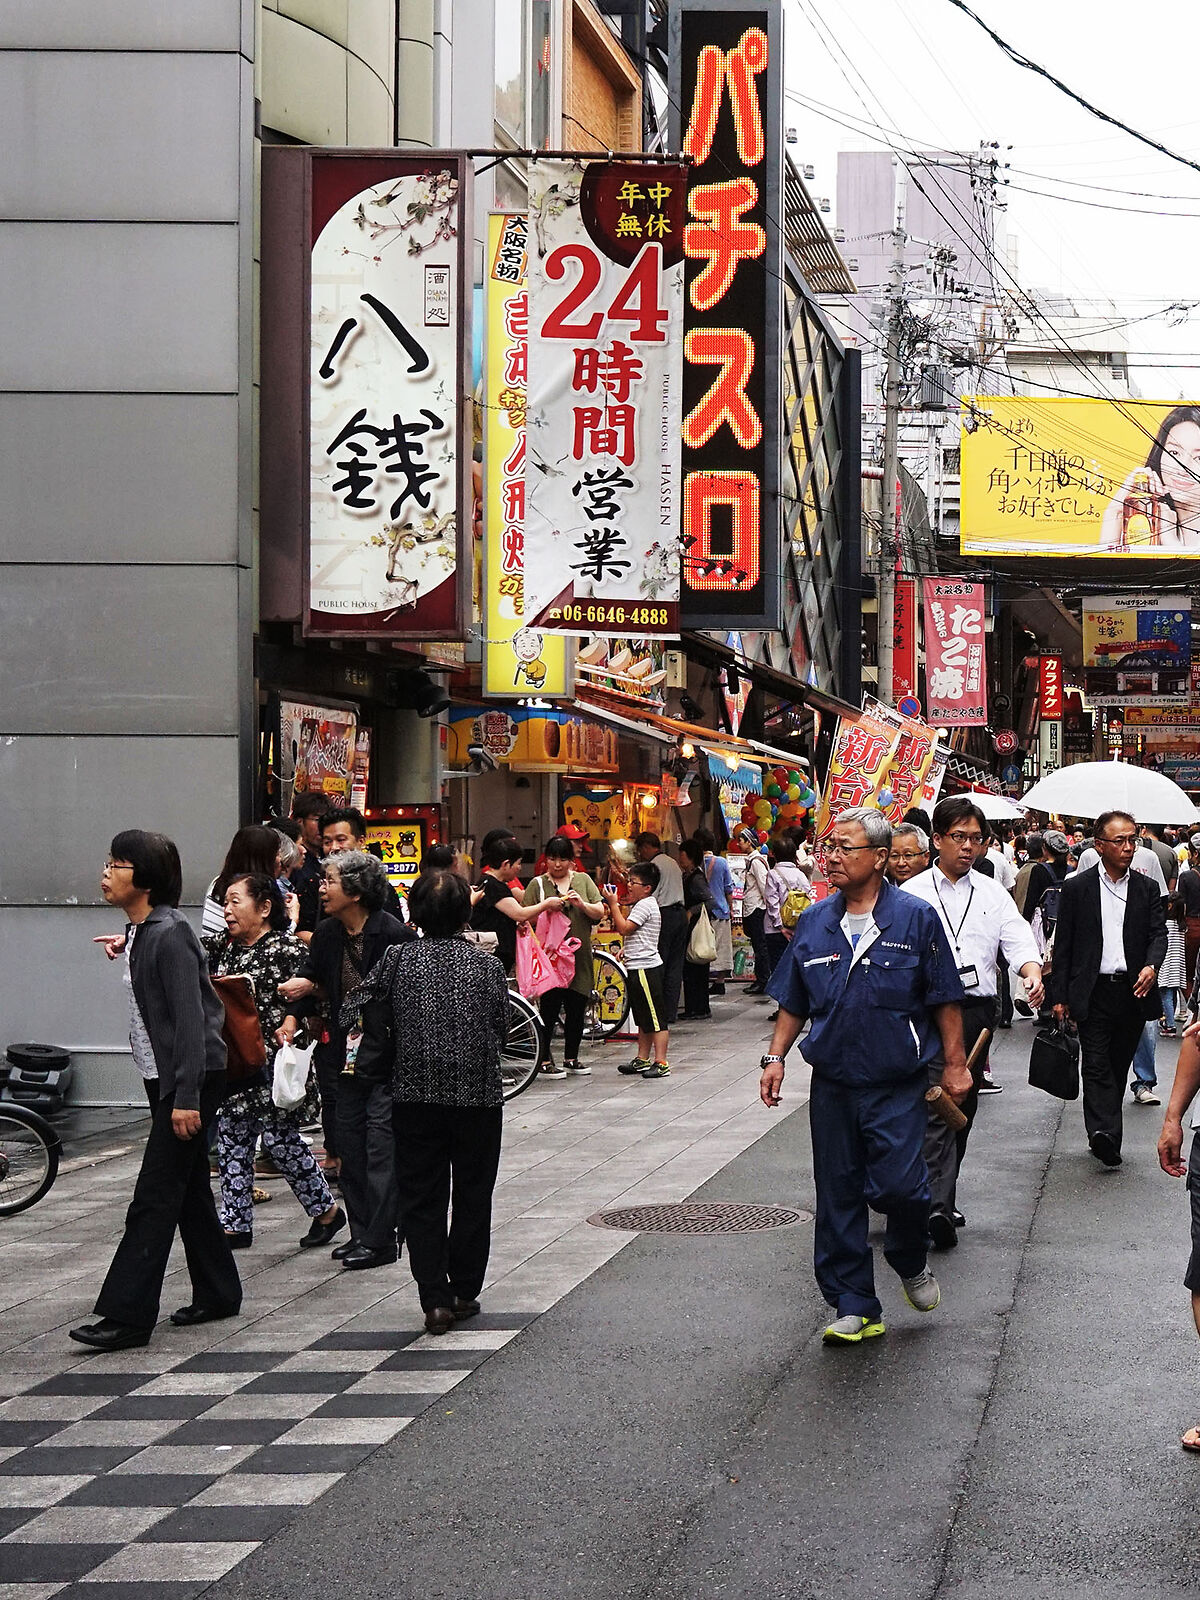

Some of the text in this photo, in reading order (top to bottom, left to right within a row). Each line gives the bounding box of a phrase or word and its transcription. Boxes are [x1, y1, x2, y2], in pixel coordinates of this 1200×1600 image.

[616, 180, 672, 208] 年中
[616, 212, 672, 238] 無休
[540, 243, 669, 341] 24
[683, 26, 770, 591] パチスロ
[319, 293, 445, 520] 八銭
[660, 374, 672, 526] PUBLIC HOUSE HASSEN
[1004, 445, 1085, 472] 千日前の
[987, 467, 1113, 495] 角ハイボールが
[998, 495, 1101, 518] お好きでしょ。
[318, 600, 378, 608] PUBLIC HOUSE
[563, 604, 669, 626] 06-6646-4888
[930, 604, 981, 700] たこ焼
[1044, 659, 1058, 709] カラオケ
